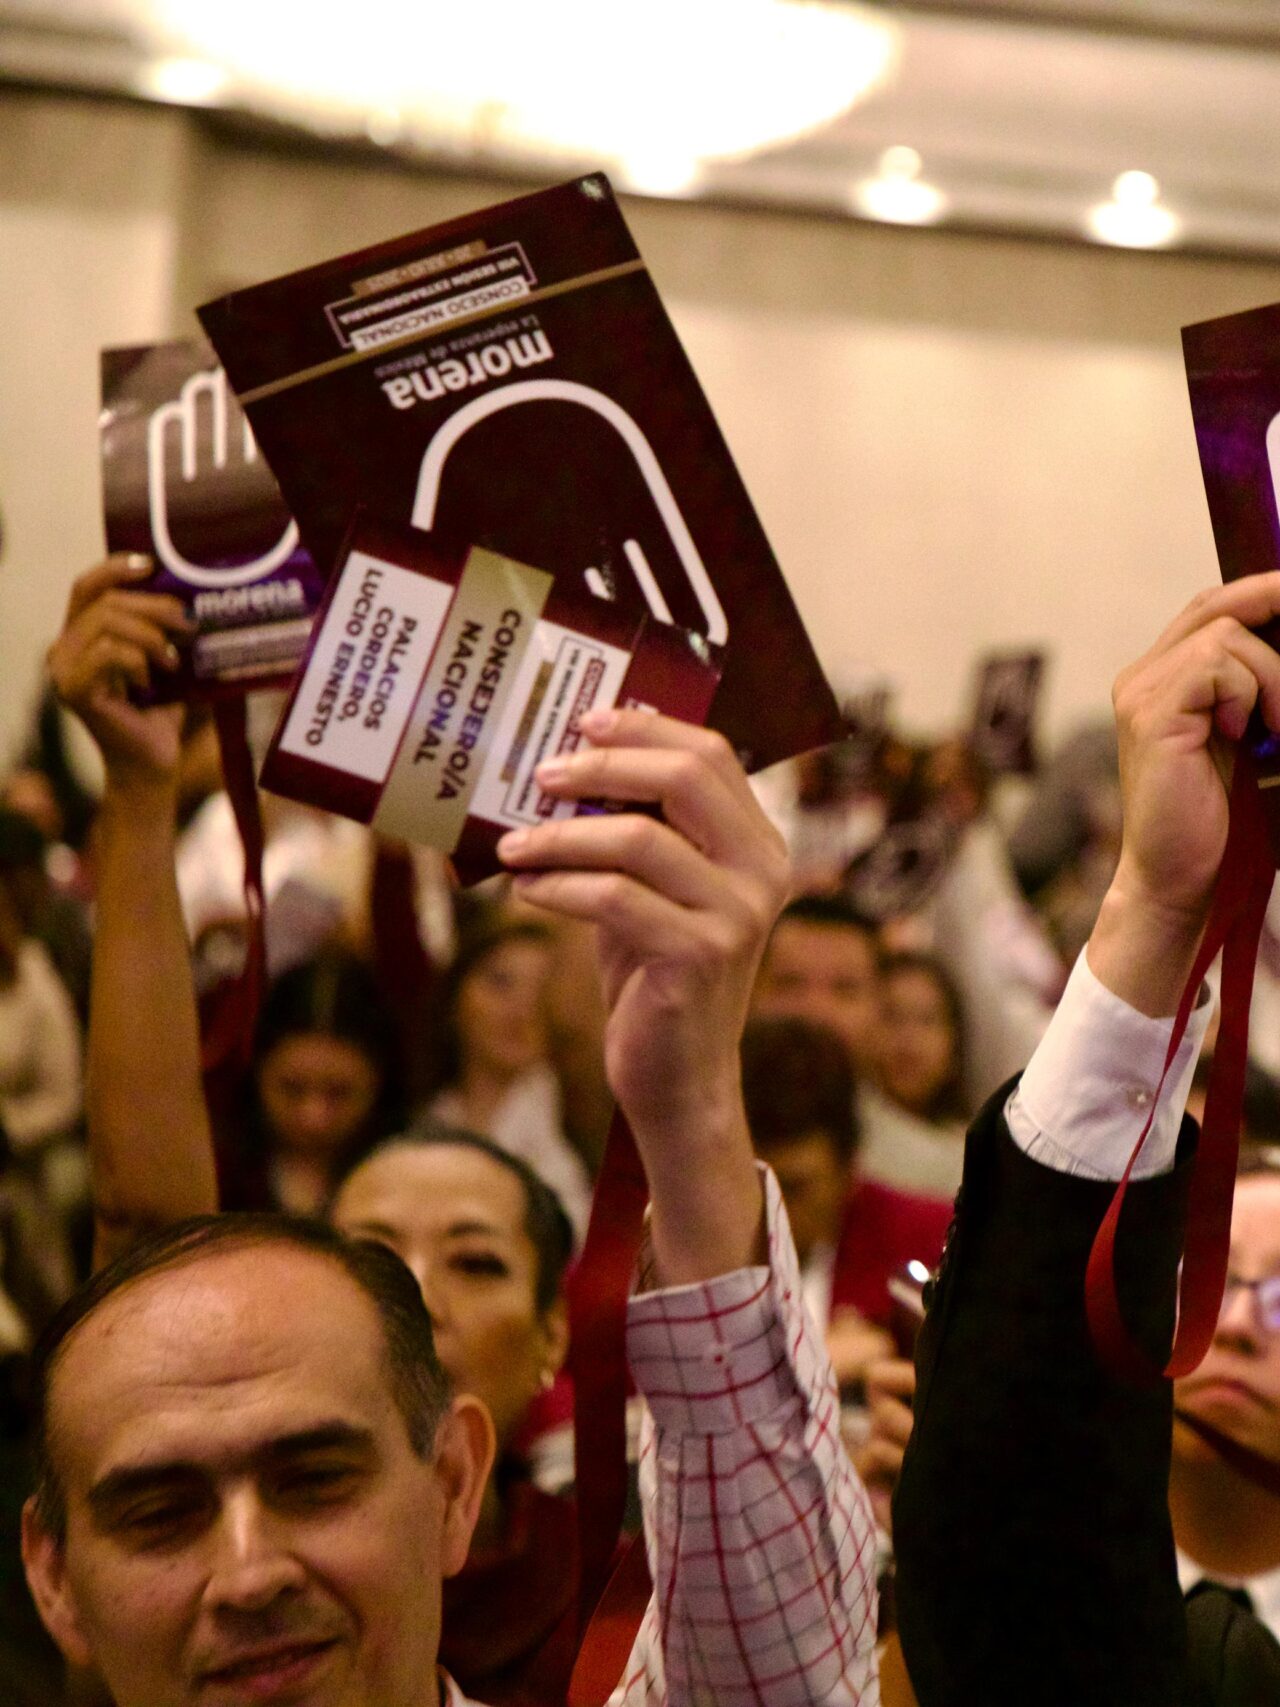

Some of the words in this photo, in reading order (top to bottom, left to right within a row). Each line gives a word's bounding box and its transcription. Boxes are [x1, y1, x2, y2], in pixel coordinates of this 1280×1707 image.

[360, 310, 445, 343] NACIONAL
[447, 281, 522, 314] CONSEJO
[381, 330, 554, 410] morena
[346, 568, 384, 638] LUCIO
[305, 642, 355, 747] ERNESTO
[338, 607, 395, 722] CORDERO,
[363, 615, 418, 731] PALACIOS
[413, 620, 483, 766] NACIONAL
[436, 608, 522, 802] CONSEJERO/A
